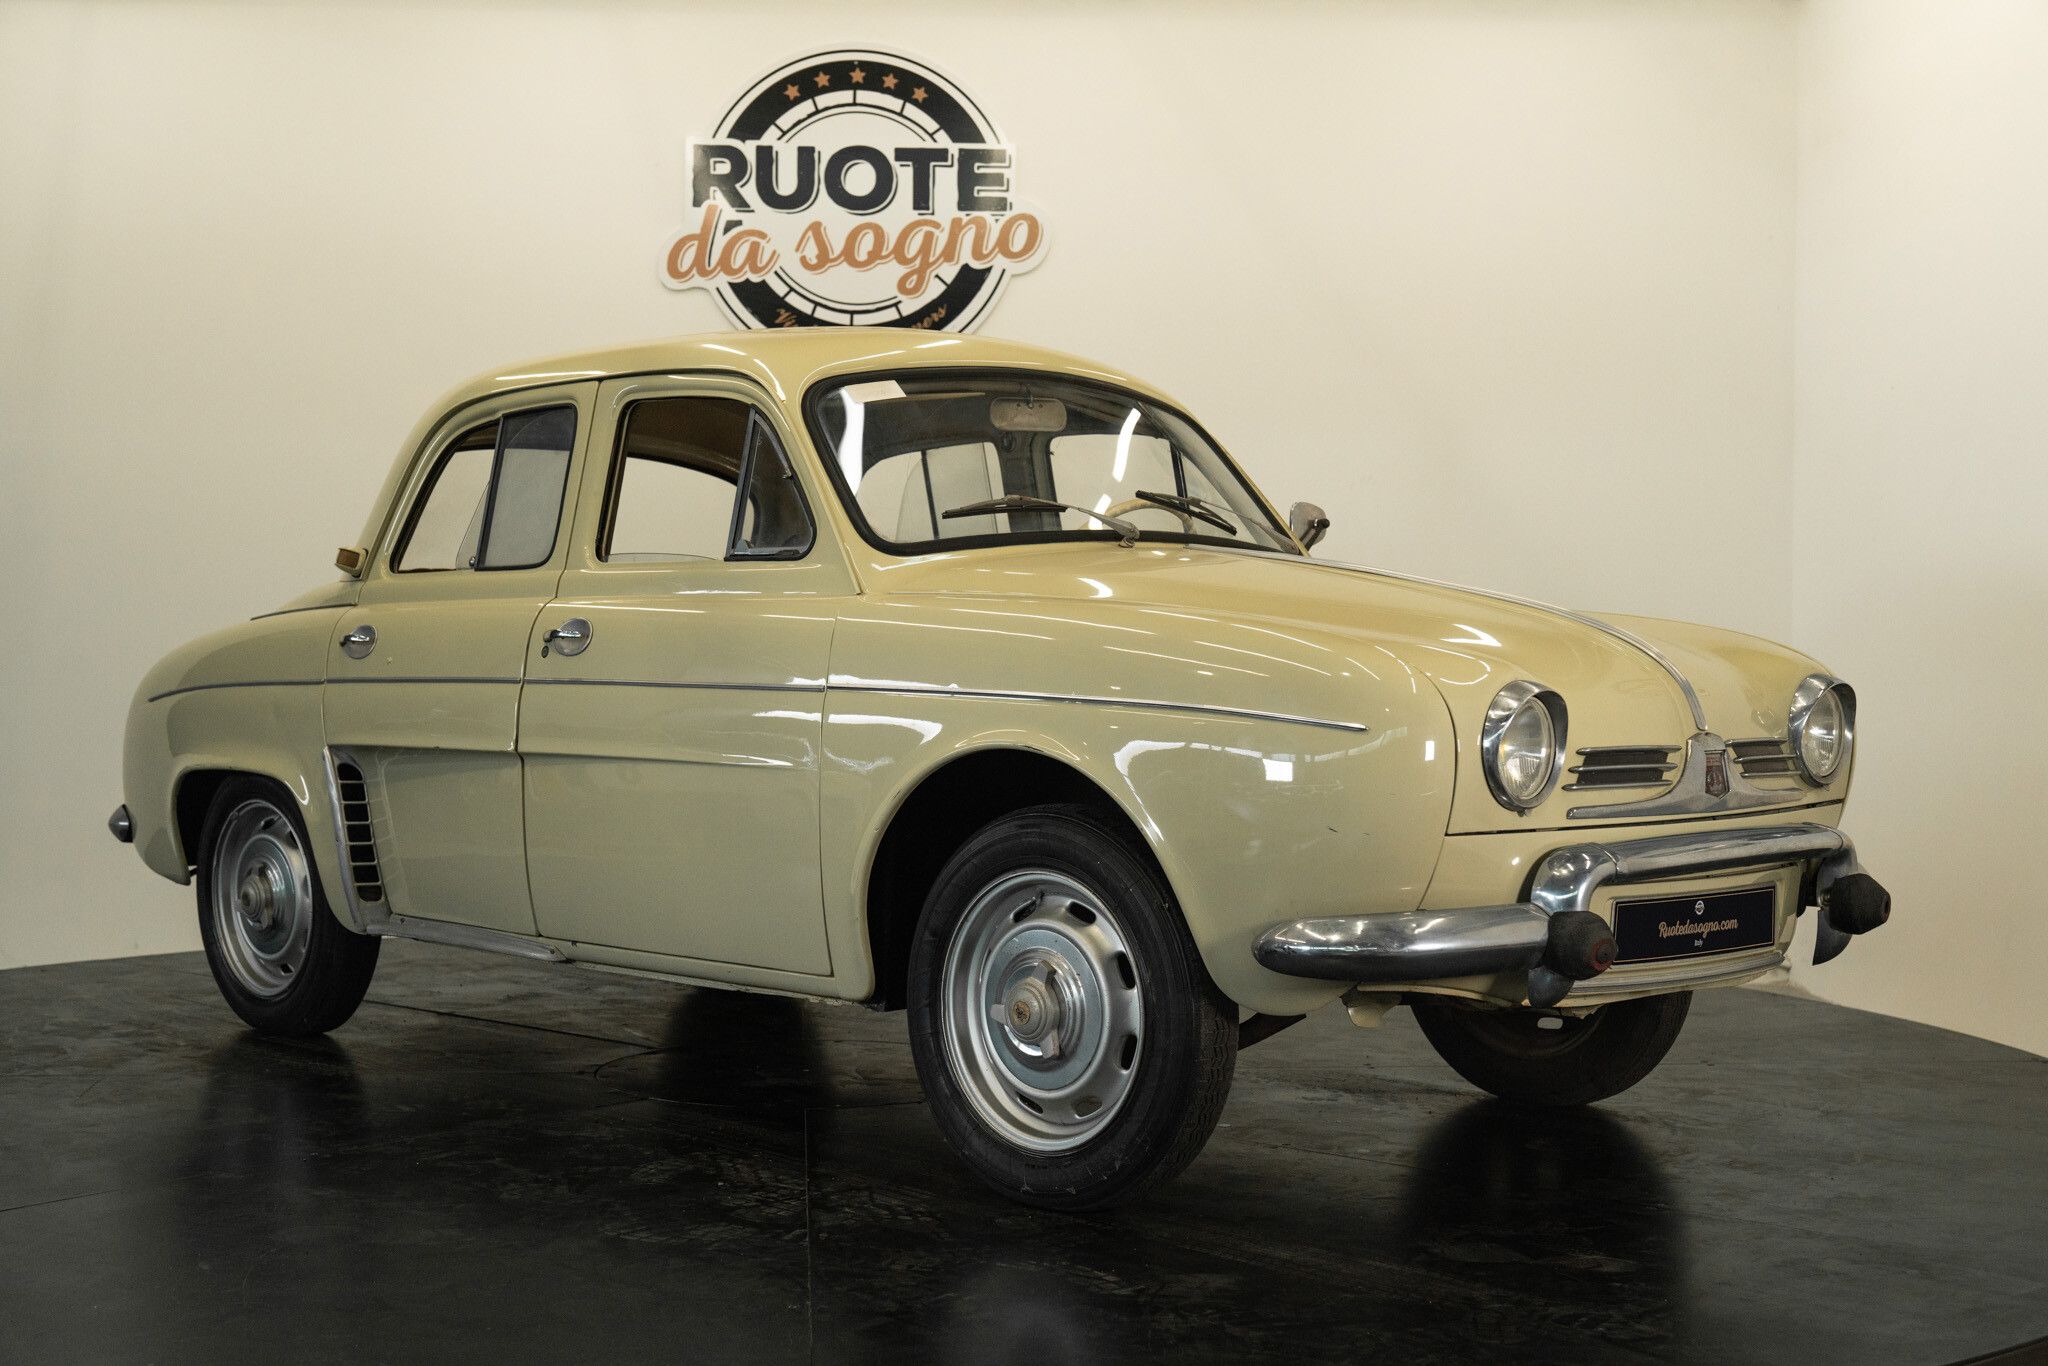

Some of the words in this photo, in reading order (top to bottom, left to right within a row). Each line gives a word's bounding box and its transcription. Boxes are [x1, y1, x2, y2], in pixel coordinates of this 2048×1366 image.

[692, 144, 1011, 215] RUOTE
[666, 202, 779, 282] da
[795, 211, 1043, 298] sogno
